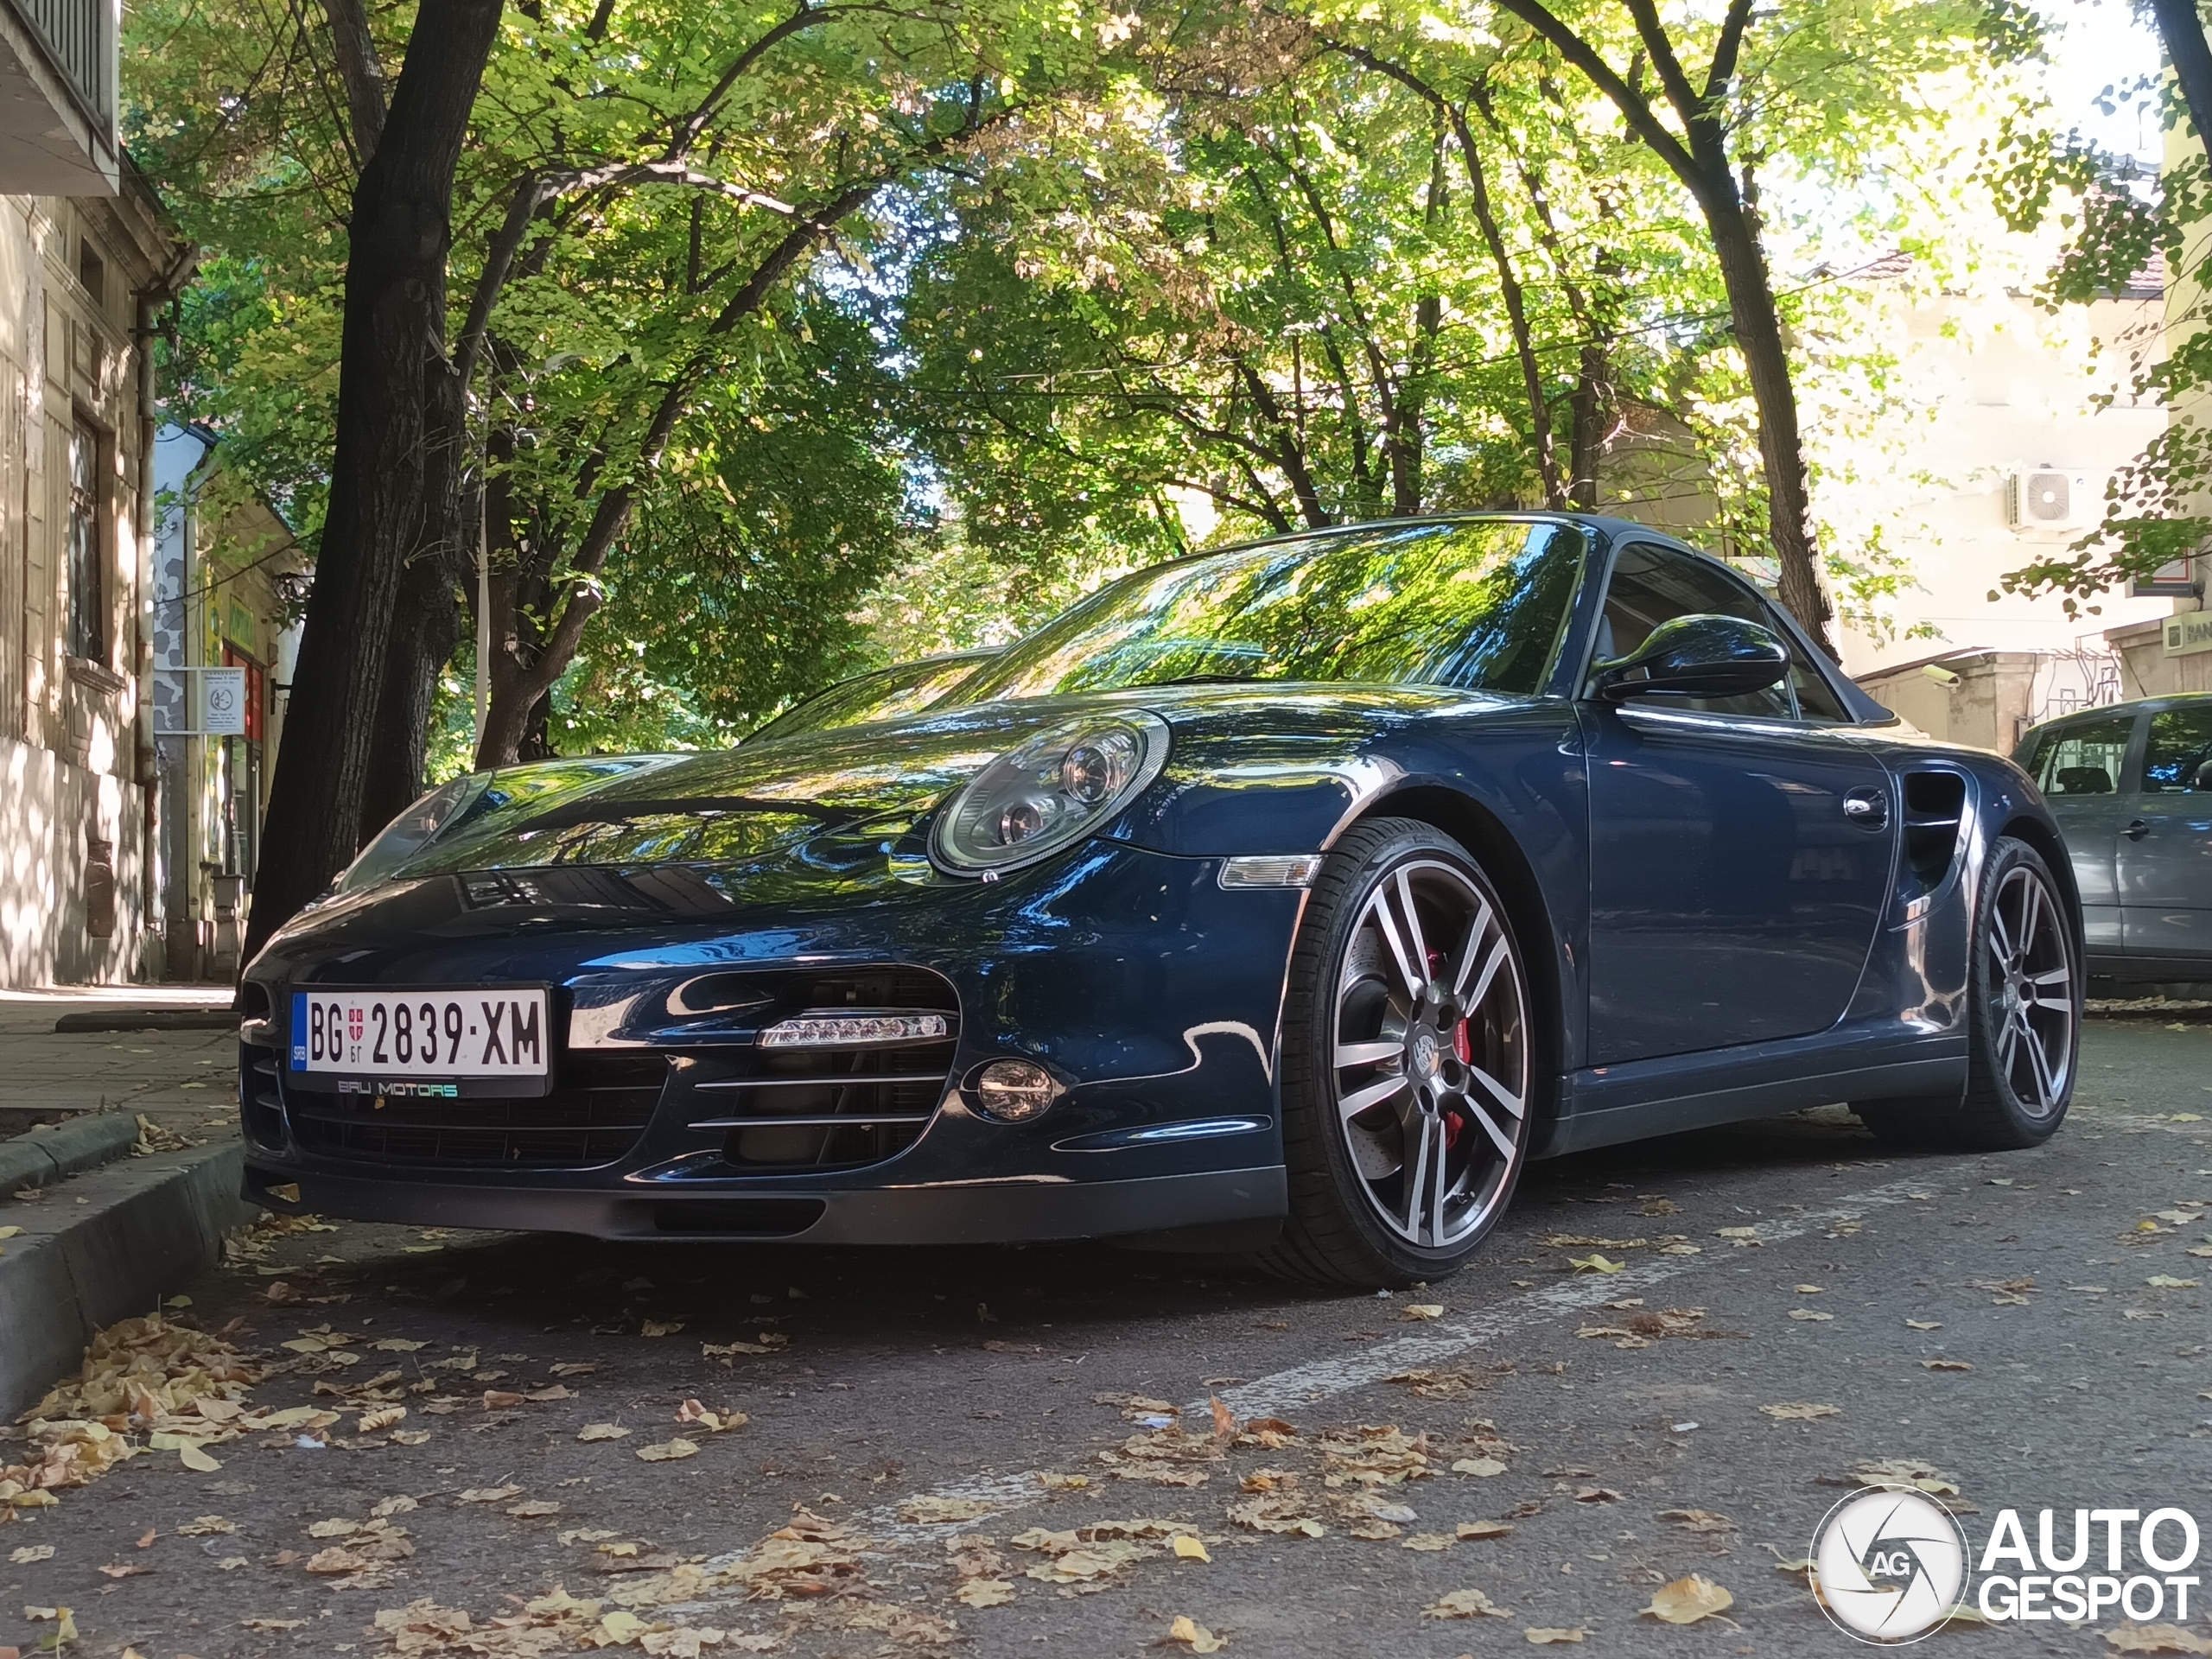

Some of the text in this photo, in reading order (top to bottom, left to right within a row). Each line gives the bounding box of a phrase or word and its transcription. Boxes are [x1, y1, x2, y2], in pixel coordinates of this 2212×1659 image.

[311, 1001, 343, 1063] BG
[294, 1046, 306, 1061] SRB
[378, 1082, 458, 1097] MOTORS
